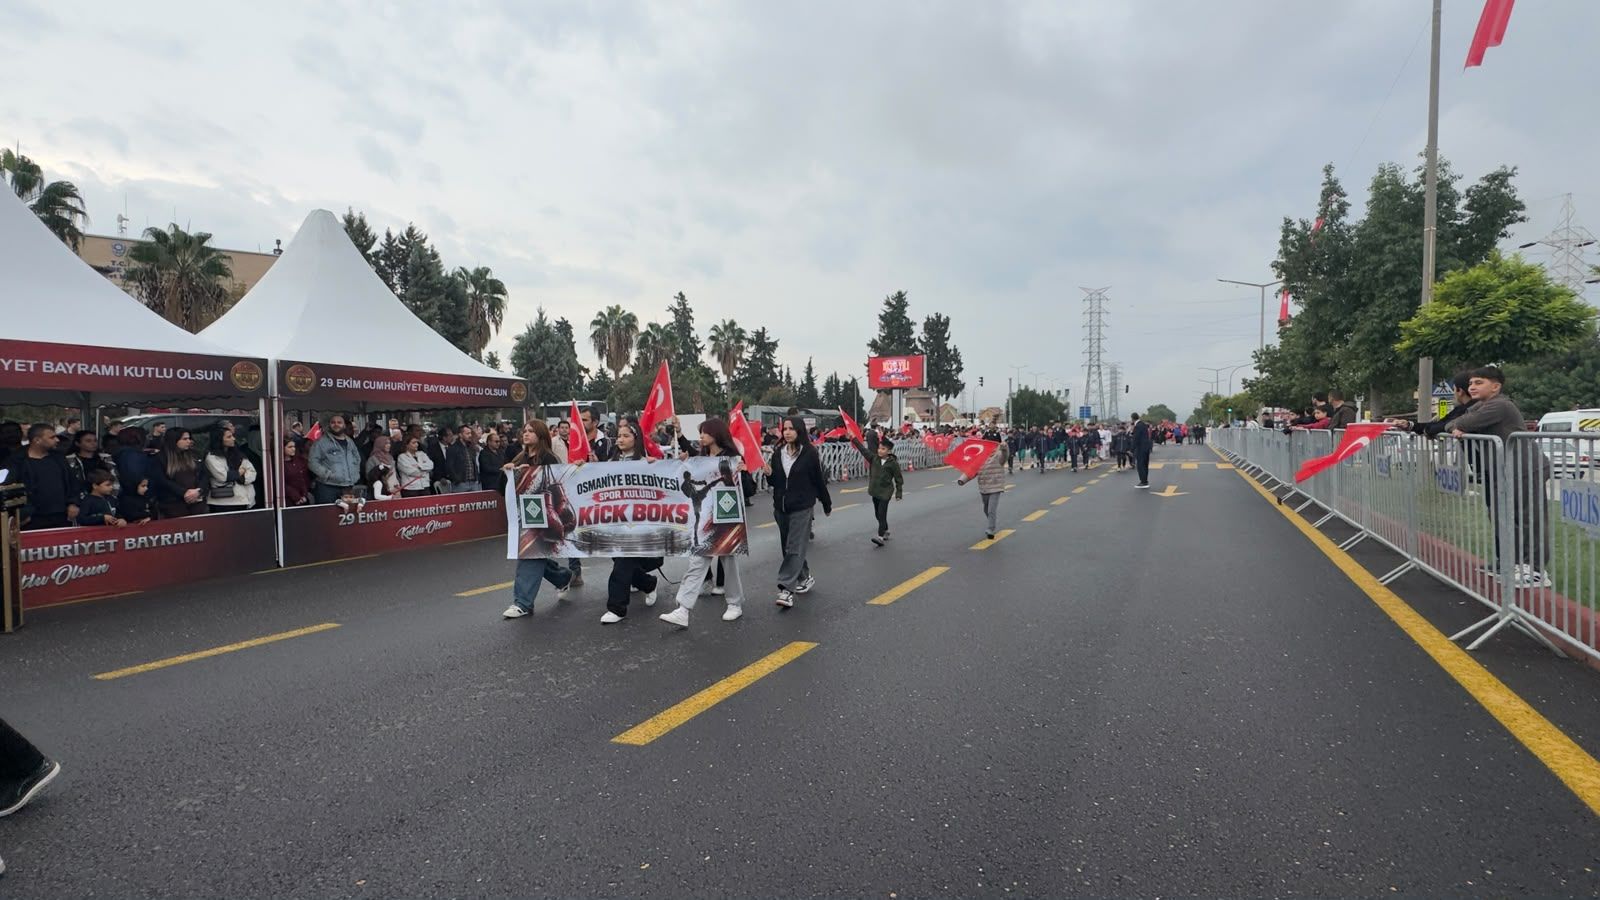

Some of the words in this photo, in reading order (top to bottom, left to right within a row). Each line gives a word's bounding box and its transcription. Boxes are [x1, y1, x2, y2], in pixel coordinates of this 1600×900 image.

[42, 361, 120, 377] BAYRAMI
[123, 365, 173, 379] KUTLU
[176, 368, 224, 382] OLSUN
[320, 377, 334, 388] 29
[336, 377, 361, 389] EKİM
[363, 380, 422, 392] CUMHURİYET
[423, 383, 459, 394] BAYRAMI
[459, 386, 484, 396] KUTLU
[484, 387, 508, 397] OLSUN
[577, 474, 624, 495] OSMANİYE
[624, 472, 680, 492] BELEDİYESİ
[599, 490, 621, 501] SPOR
[623, 489, 657, 500] KULÜBÜ
[338, 513, 355, 526] 29
[358, 511, 388, 524] EKİM
[392, 504, 456, 520] CUMHURİYET
[459, 500, 498, 512] BAYRAMI
[632, 503, 690, 524] BOKS
[1562, 487, 1599, 526] POLİS
[124, 530, 204, 551] BAYRAMI
[396, 525, 425, 541] Kutlu
[425, 519, 453, 534] Olsun
[51, 563, 110, 586] Olsun
